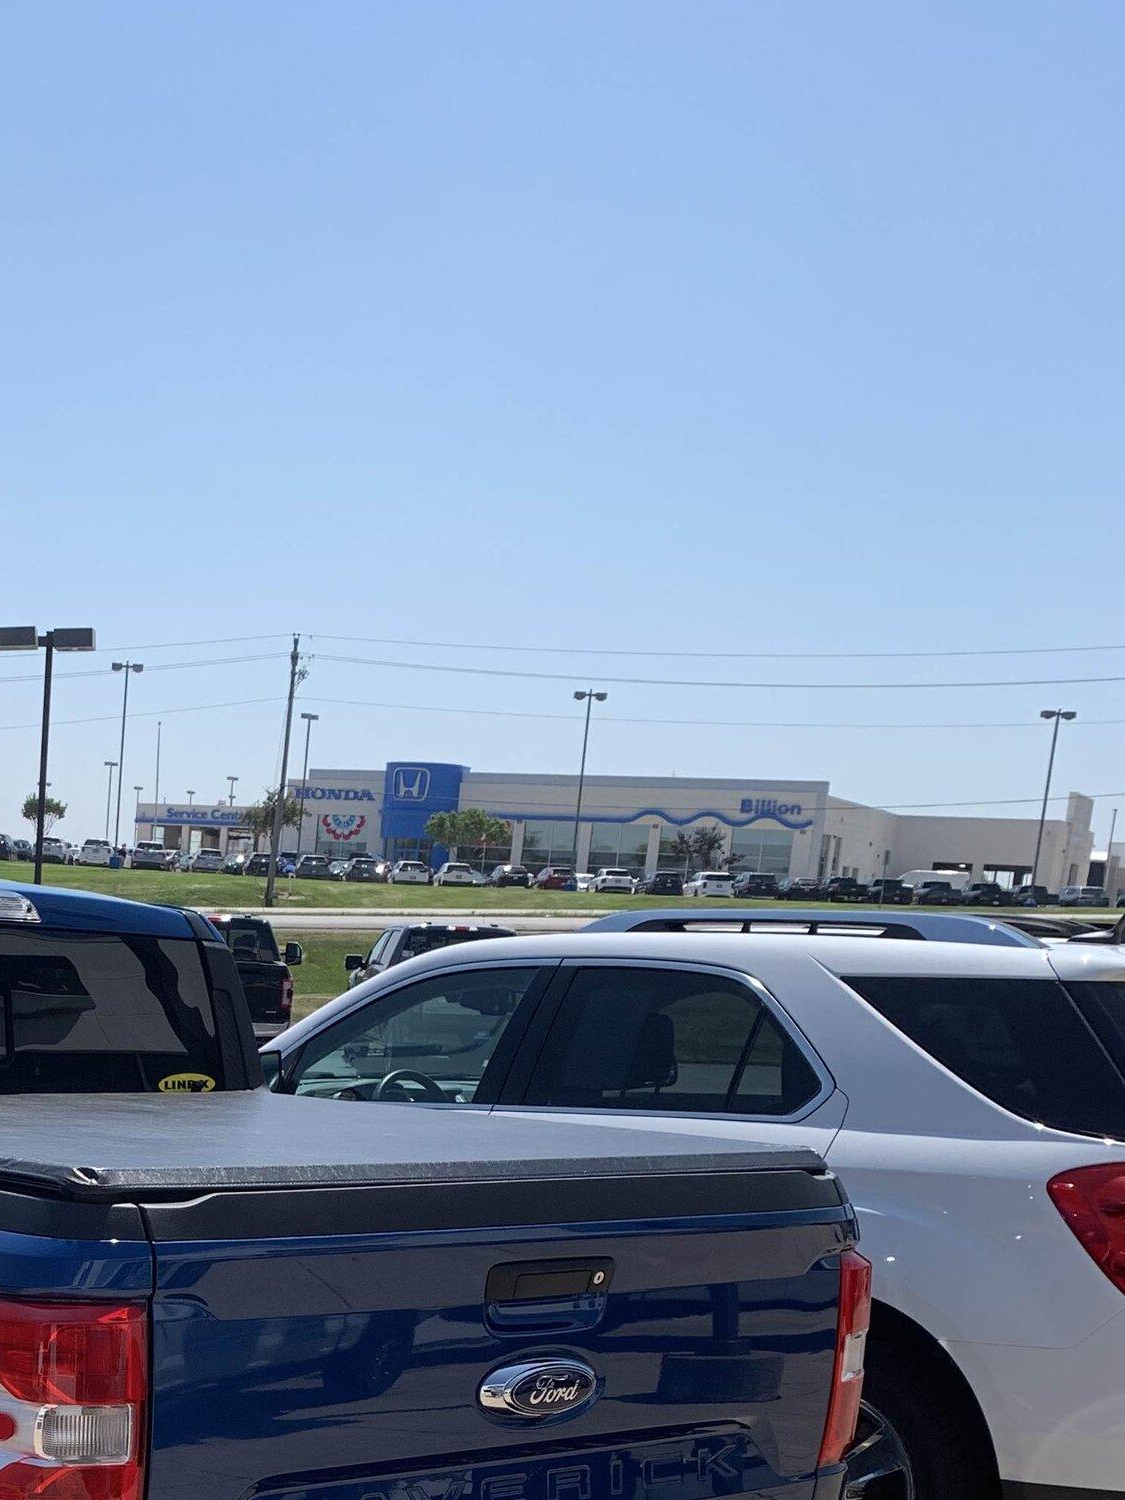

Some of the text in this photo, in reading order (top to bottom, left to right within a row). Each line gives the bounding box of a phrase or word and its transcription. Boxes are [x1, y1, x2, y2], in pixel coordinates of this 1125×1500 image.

[294, 787, 376, 801] HONDA
[166, 807, 240, 820] Service Cent
[740, 799, 802, 815] Billion
[529, 1374, 581, 1405] Ford
